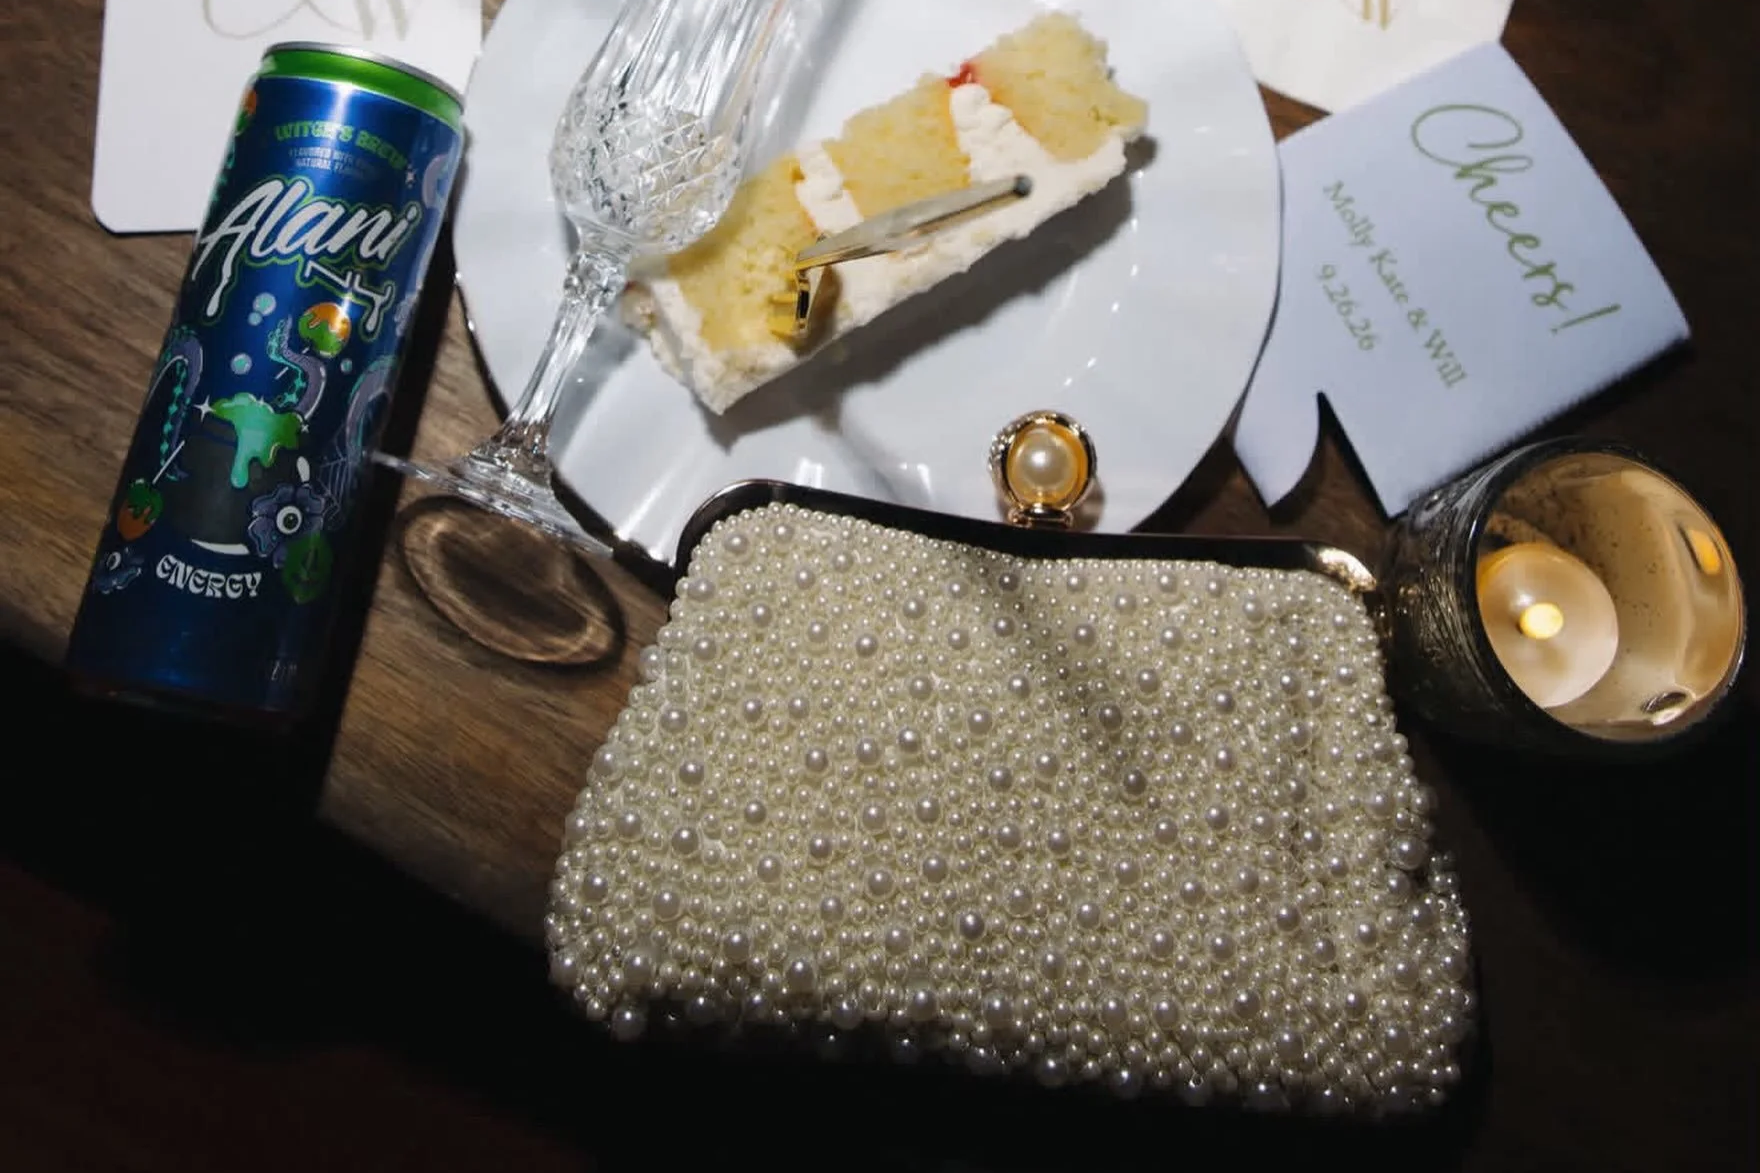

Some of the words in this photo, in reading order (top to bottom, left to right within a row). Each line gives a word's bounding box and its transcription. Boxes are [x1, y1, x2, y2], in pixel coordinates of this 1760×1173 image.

[355, 130, 408, 170] BREW
[191, 179, 418, 317] Alani
[1411, 104, 1621, 334] Cheers!
[1317, 263, 1378, 351] 9.26.26
[1322, 180, 1376, 247] Molly
[1368, 249, 1409, 303] Kate
[1407, 308, 1429, 333] &
[1424, 328, 1467, 388] Will
[155, 553, 262, 600] ENERGY
